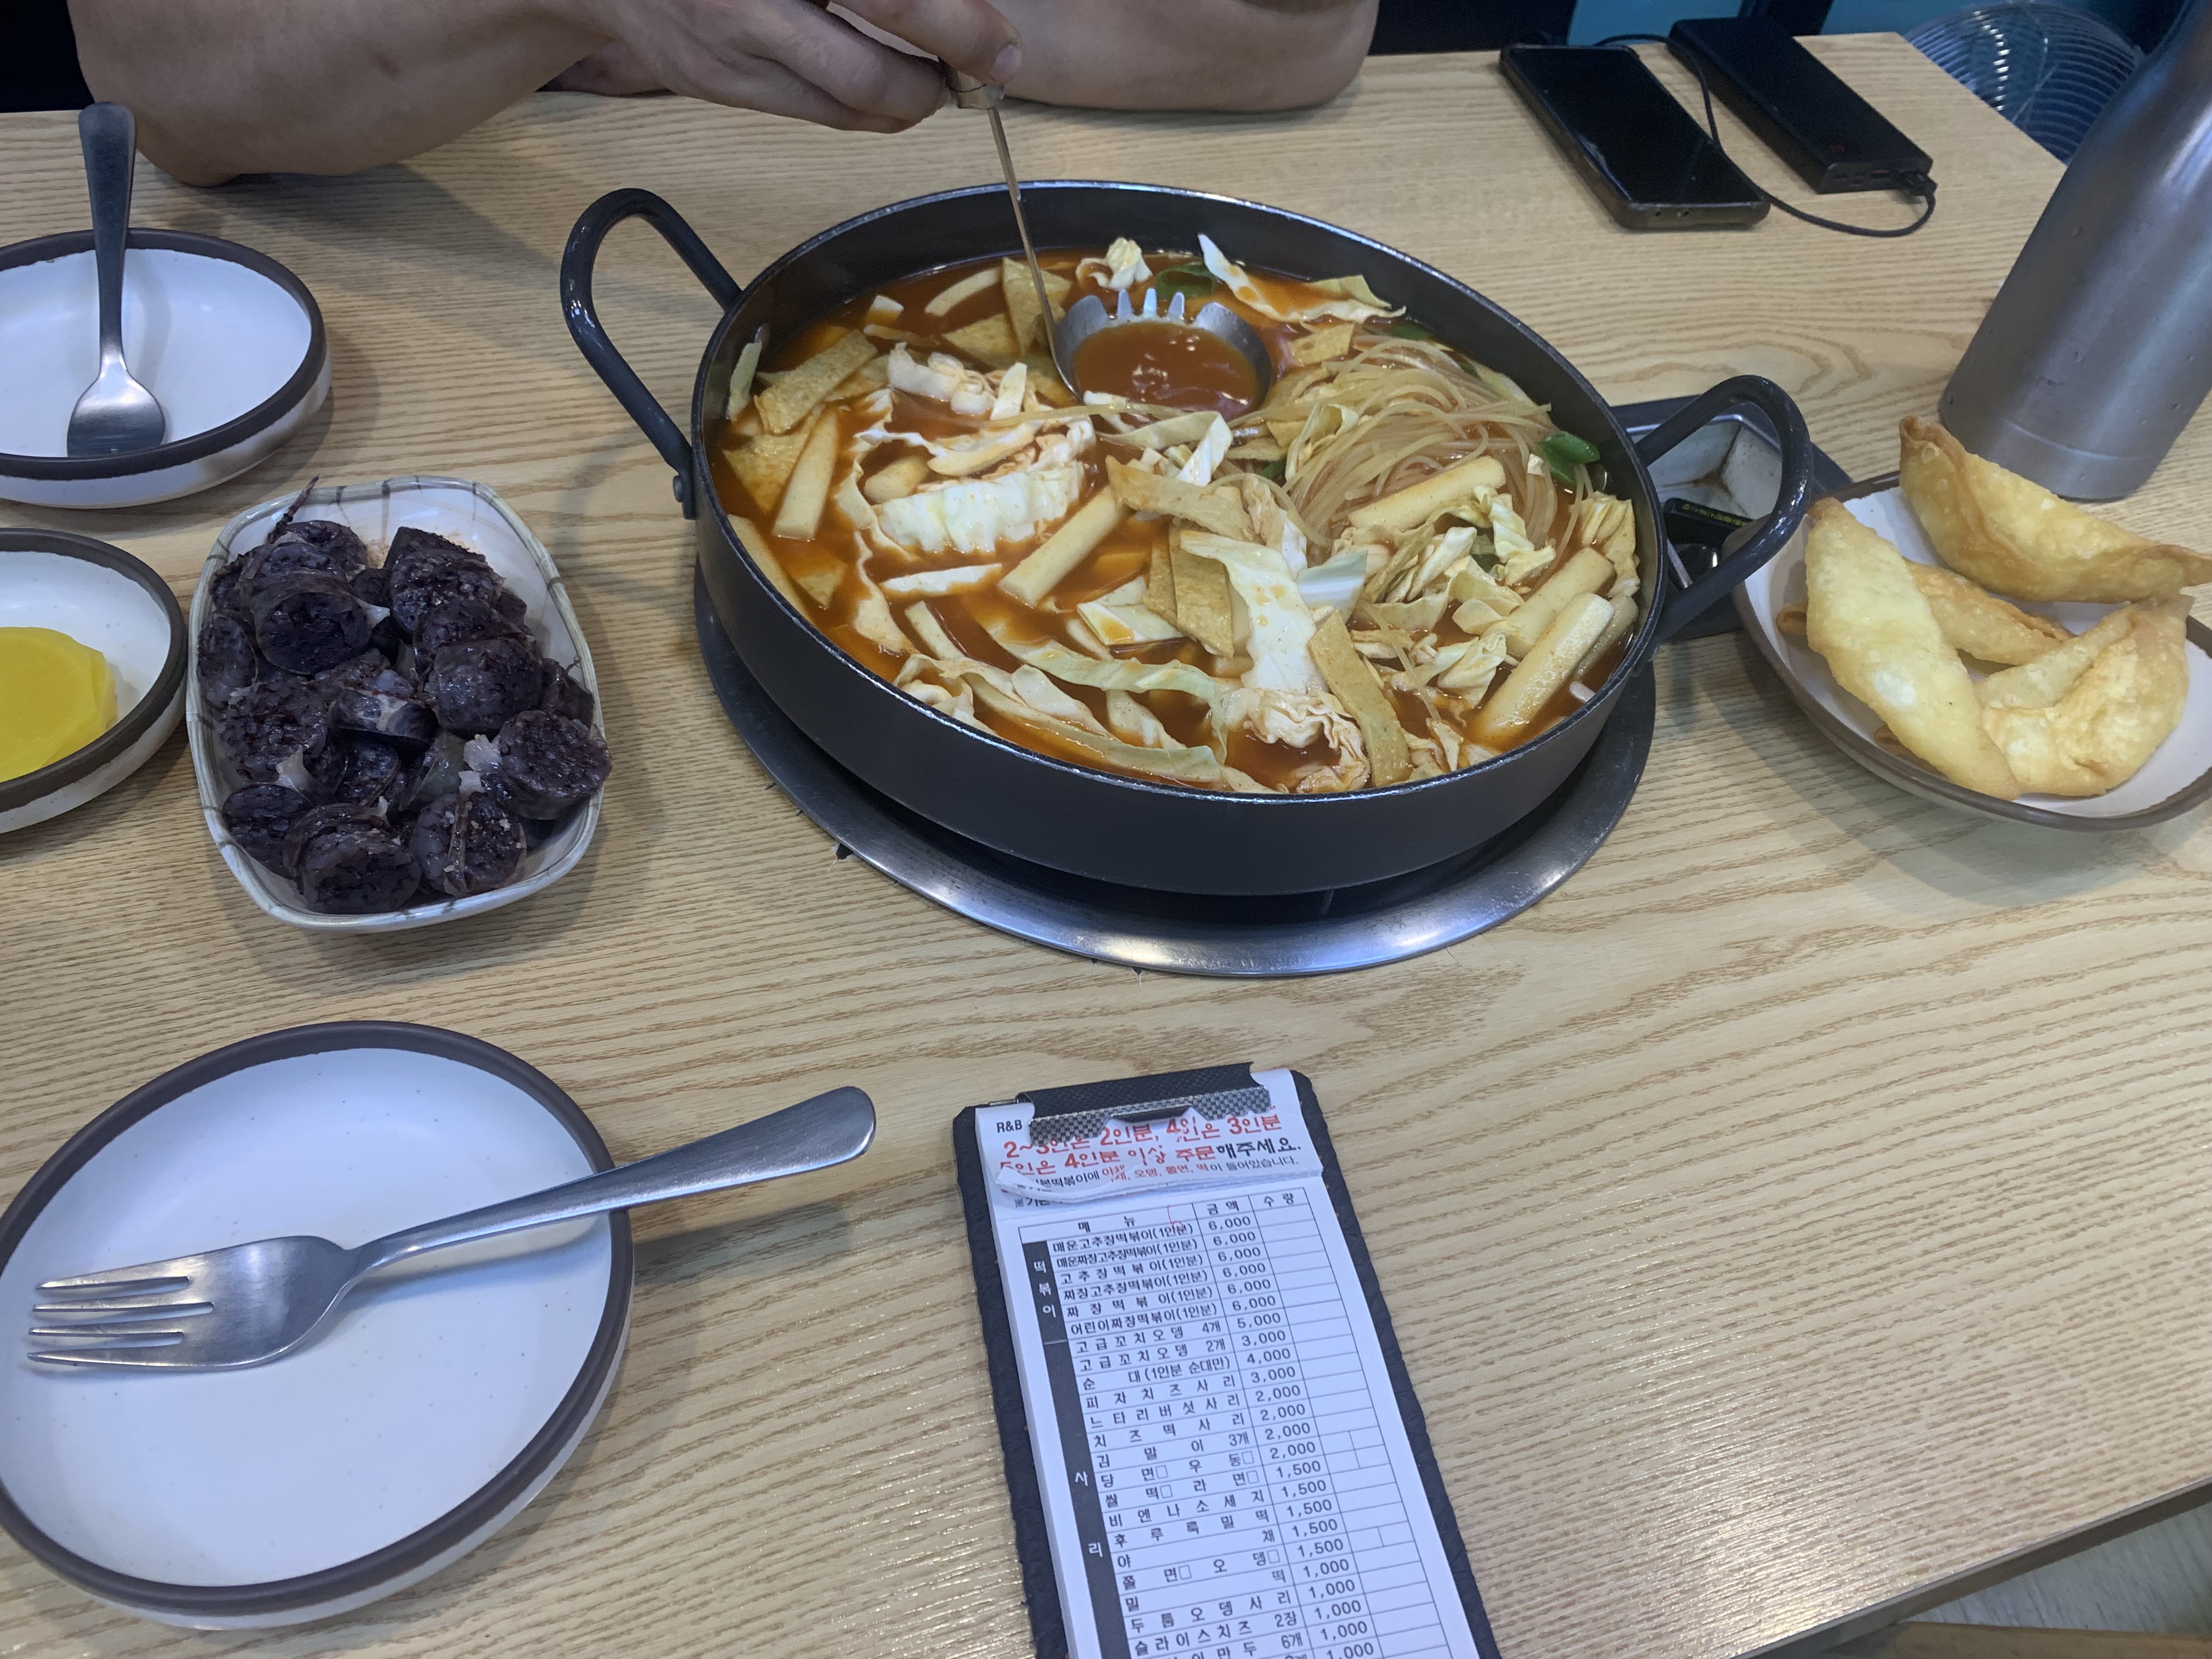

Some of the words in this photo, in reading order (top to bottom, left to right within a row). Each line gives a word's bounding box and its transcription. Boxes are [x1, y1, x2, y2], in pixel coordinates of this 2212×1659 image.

[996, 1119, 1023, 1133] R&B
[1227, 1114, 1282, 1135] 3인분
[1064, 1150, 1120, 1168] 4인분
[1208, 1216, 1251, 1231] 6,000
[1213, 1231, 1256, 1246] 6,000
[1217, 1246, 1261, 1262] 6,000
[1222, 1262, 1266, 1278] 6,000
[1227, 1279, 1271, 1294] 6,000
[1232, 1295, 1276, 1311] 6,000
[1202, 1320, 1221, 1334] 4개
[1237, 1312, 1281, 1329] 5,000
[1205, 1338, 1226, 1352] 2개
[1241, 1330, 1286, 1347] 3,000
[1246, 1348, 1291, 1365] 4,000
[1250, 1366, 1296, 1384] 3,000
[1255, 1385, 1301, 1402] 2,000
[1260, 1403, 1306, 1421] 2,000
[1228, 1431, 1249, 1447] 3개
[1265, 1422, 1311, 1440] 2,000
[1269, 1441, 1316, 1459] 2,000
[1276, 1460, 1321, 1479] 1,500
[1281, 1480, 1327, 1498] 1,500
[1286, 1499, 1332, 1517] 1,500
[1292, 1519, 1338, 1537] 1,500
[1297, 1538, 1344, 1558] 1,500
[1303, 1559, 1350, 1578] 1,000
[1308, 1579, 1356, 1599] 1,000
[1274, 1610, 1297, 1628] 2장
[1314, 1600, 1362, 1620] 1,000
[1281, 1632, 1304, 1649] 6개
[1321, 1621, 1368, 1641] 1,000
